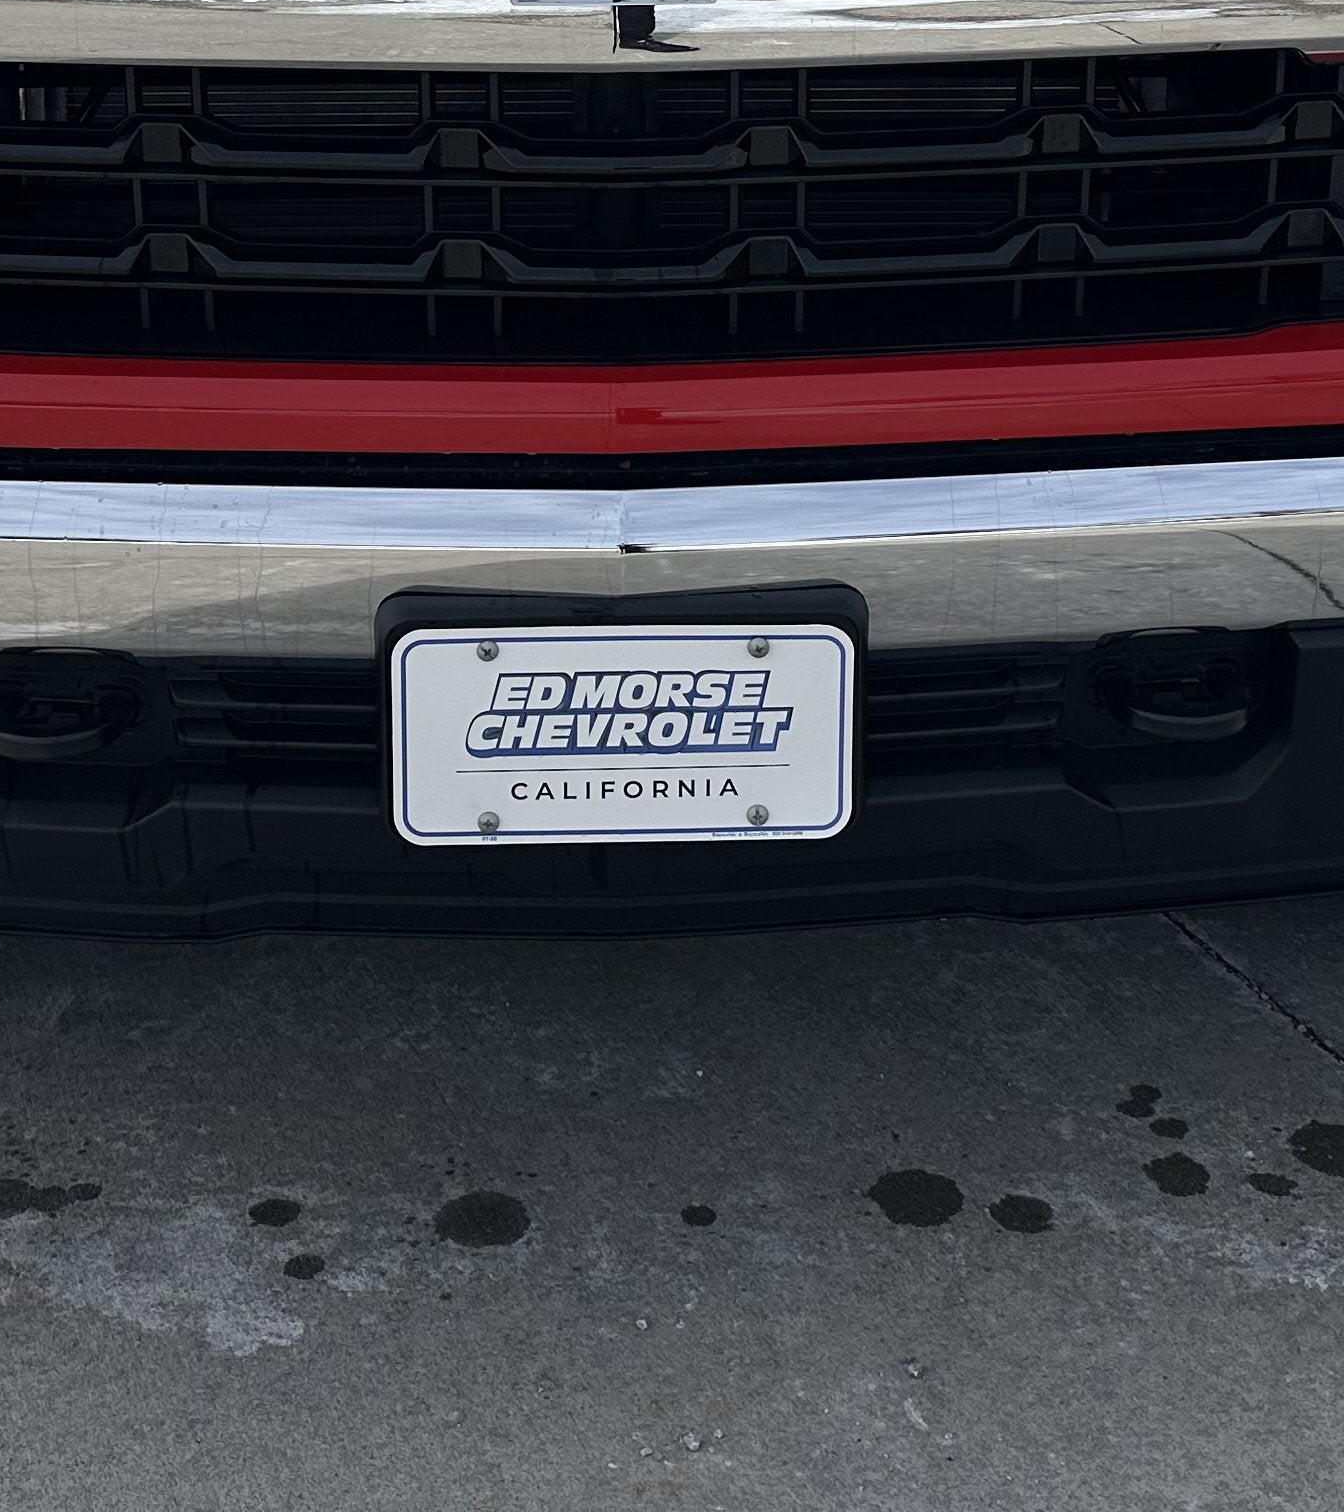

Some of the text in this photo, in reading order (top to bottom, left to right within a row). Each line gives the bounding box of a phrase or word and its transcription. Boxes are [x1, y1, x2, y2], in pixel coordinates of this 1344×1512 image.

[491, 671, 769, 710] ED MORSE
[466, 708, 792, 754] CHEVROLET
[511, 778, 739, 799] CALIFORNIA
